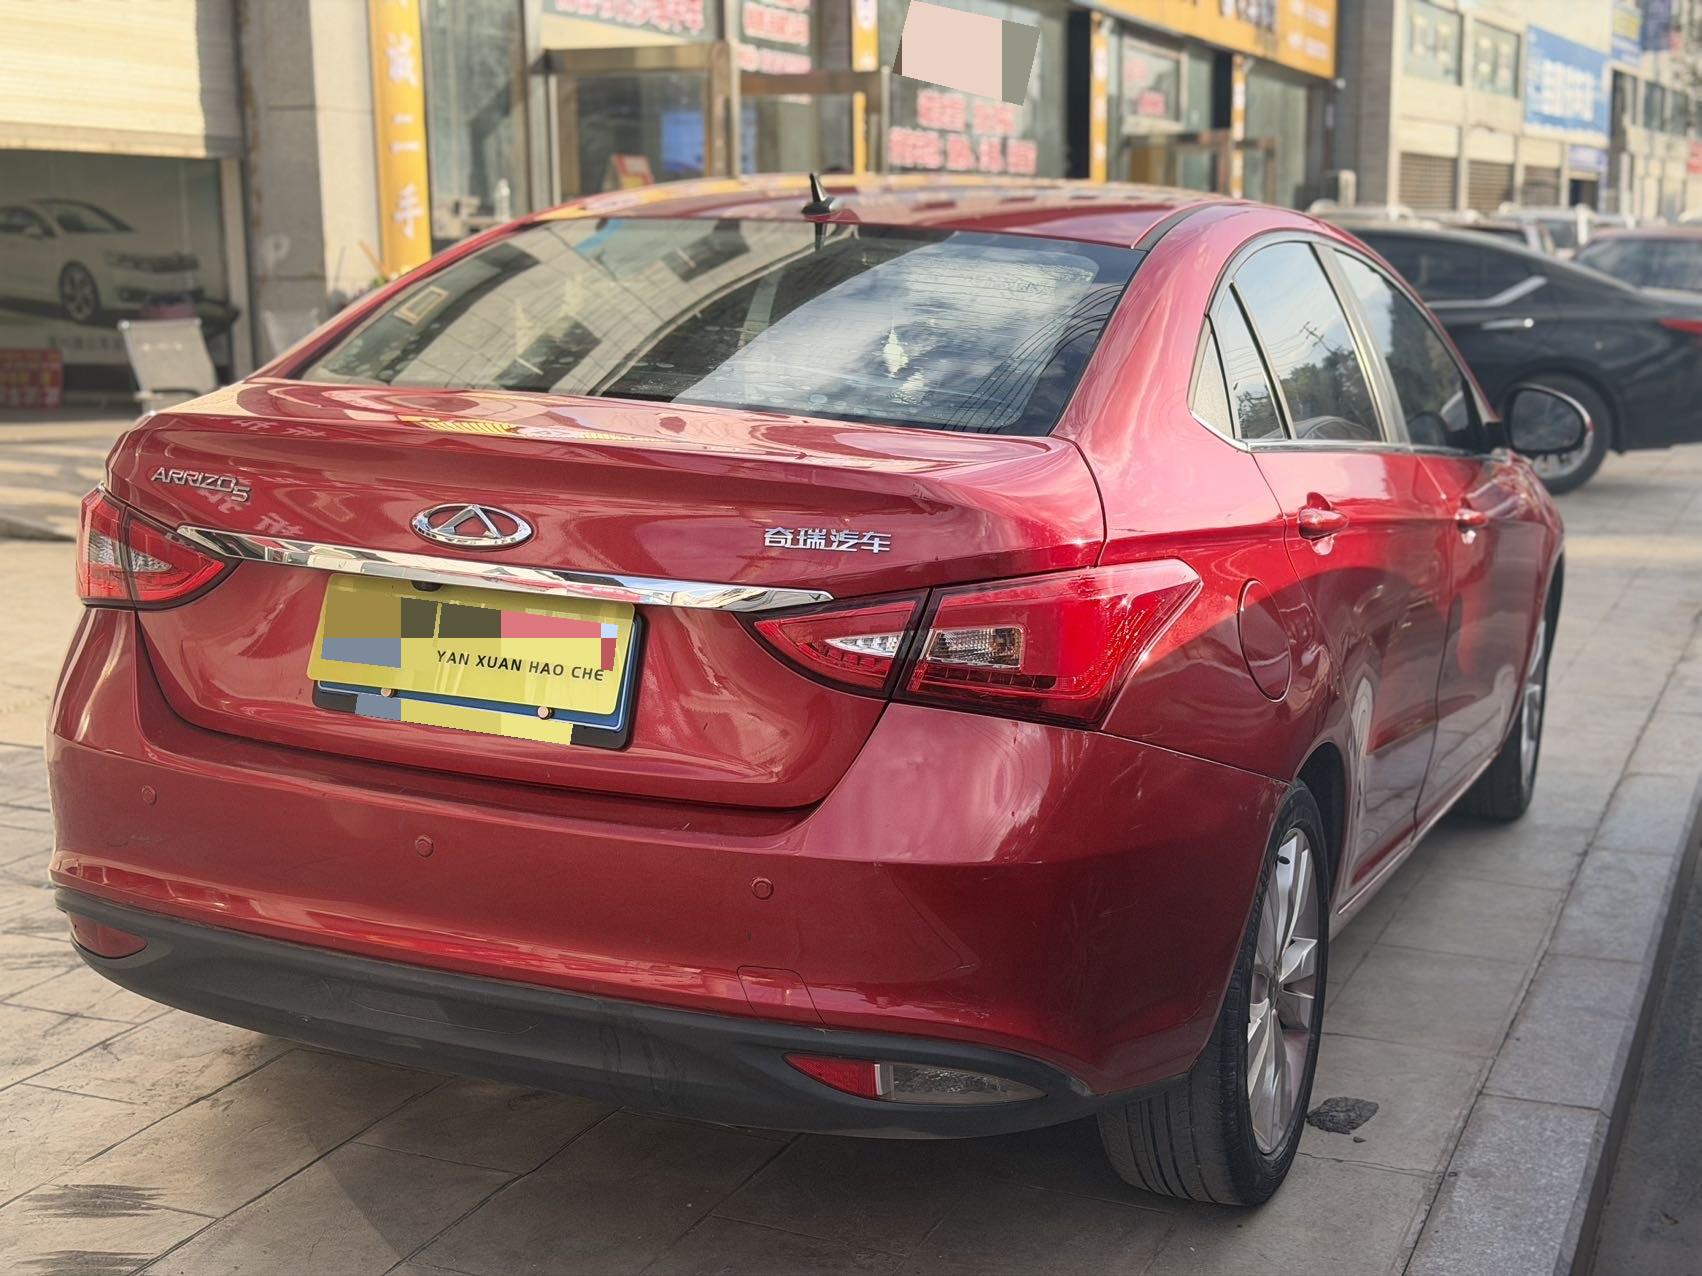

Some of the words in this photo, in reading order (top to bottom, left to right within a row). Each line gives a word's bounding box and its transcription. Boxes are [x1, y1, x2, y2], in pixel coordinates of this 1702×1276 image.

[764, 526, 891, 553] 奇瑞汽车
[437, 650, 470, 666] YAN
[476, 654, 522, 672] XUAN
[529, 661, 564, 676] HAO
[571, 666, 604, 681] CHE
